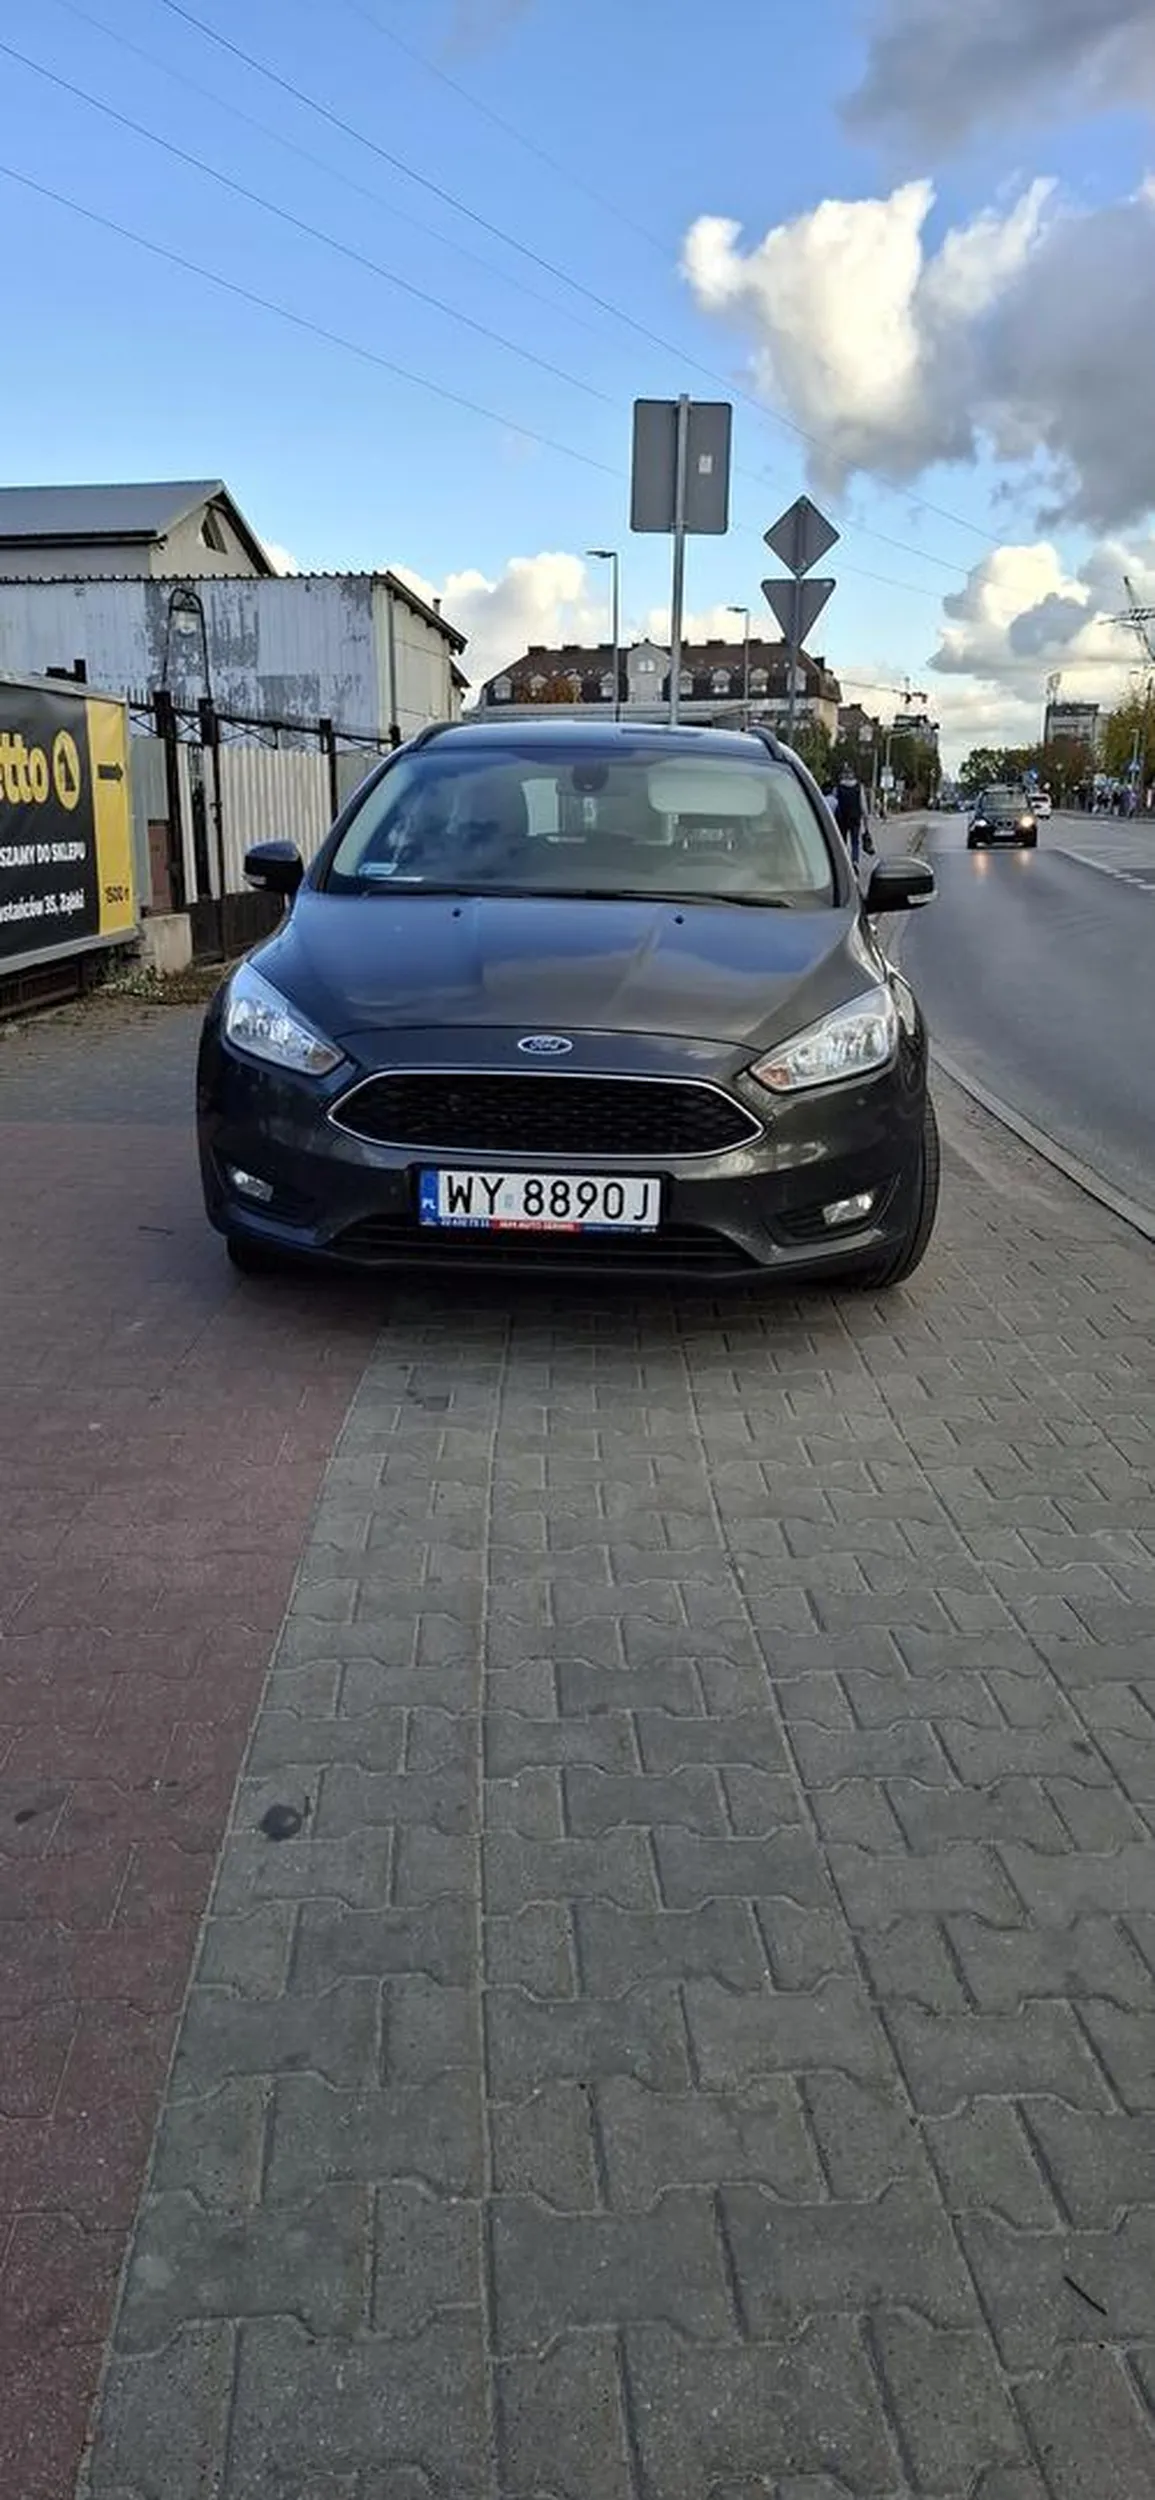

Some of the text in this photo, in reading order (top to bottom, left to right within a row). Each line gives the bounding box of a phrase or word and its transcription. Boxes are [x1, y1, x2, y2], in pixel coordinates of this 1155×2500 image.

[0, 733, 49, 803] tto
[37, 843, 50, 864] DO
[51, 841, 86, 862] SKLEPU
[421, 1198, 437, 1210] PL
[446, 1175, 649, 1220] WY 8890J
